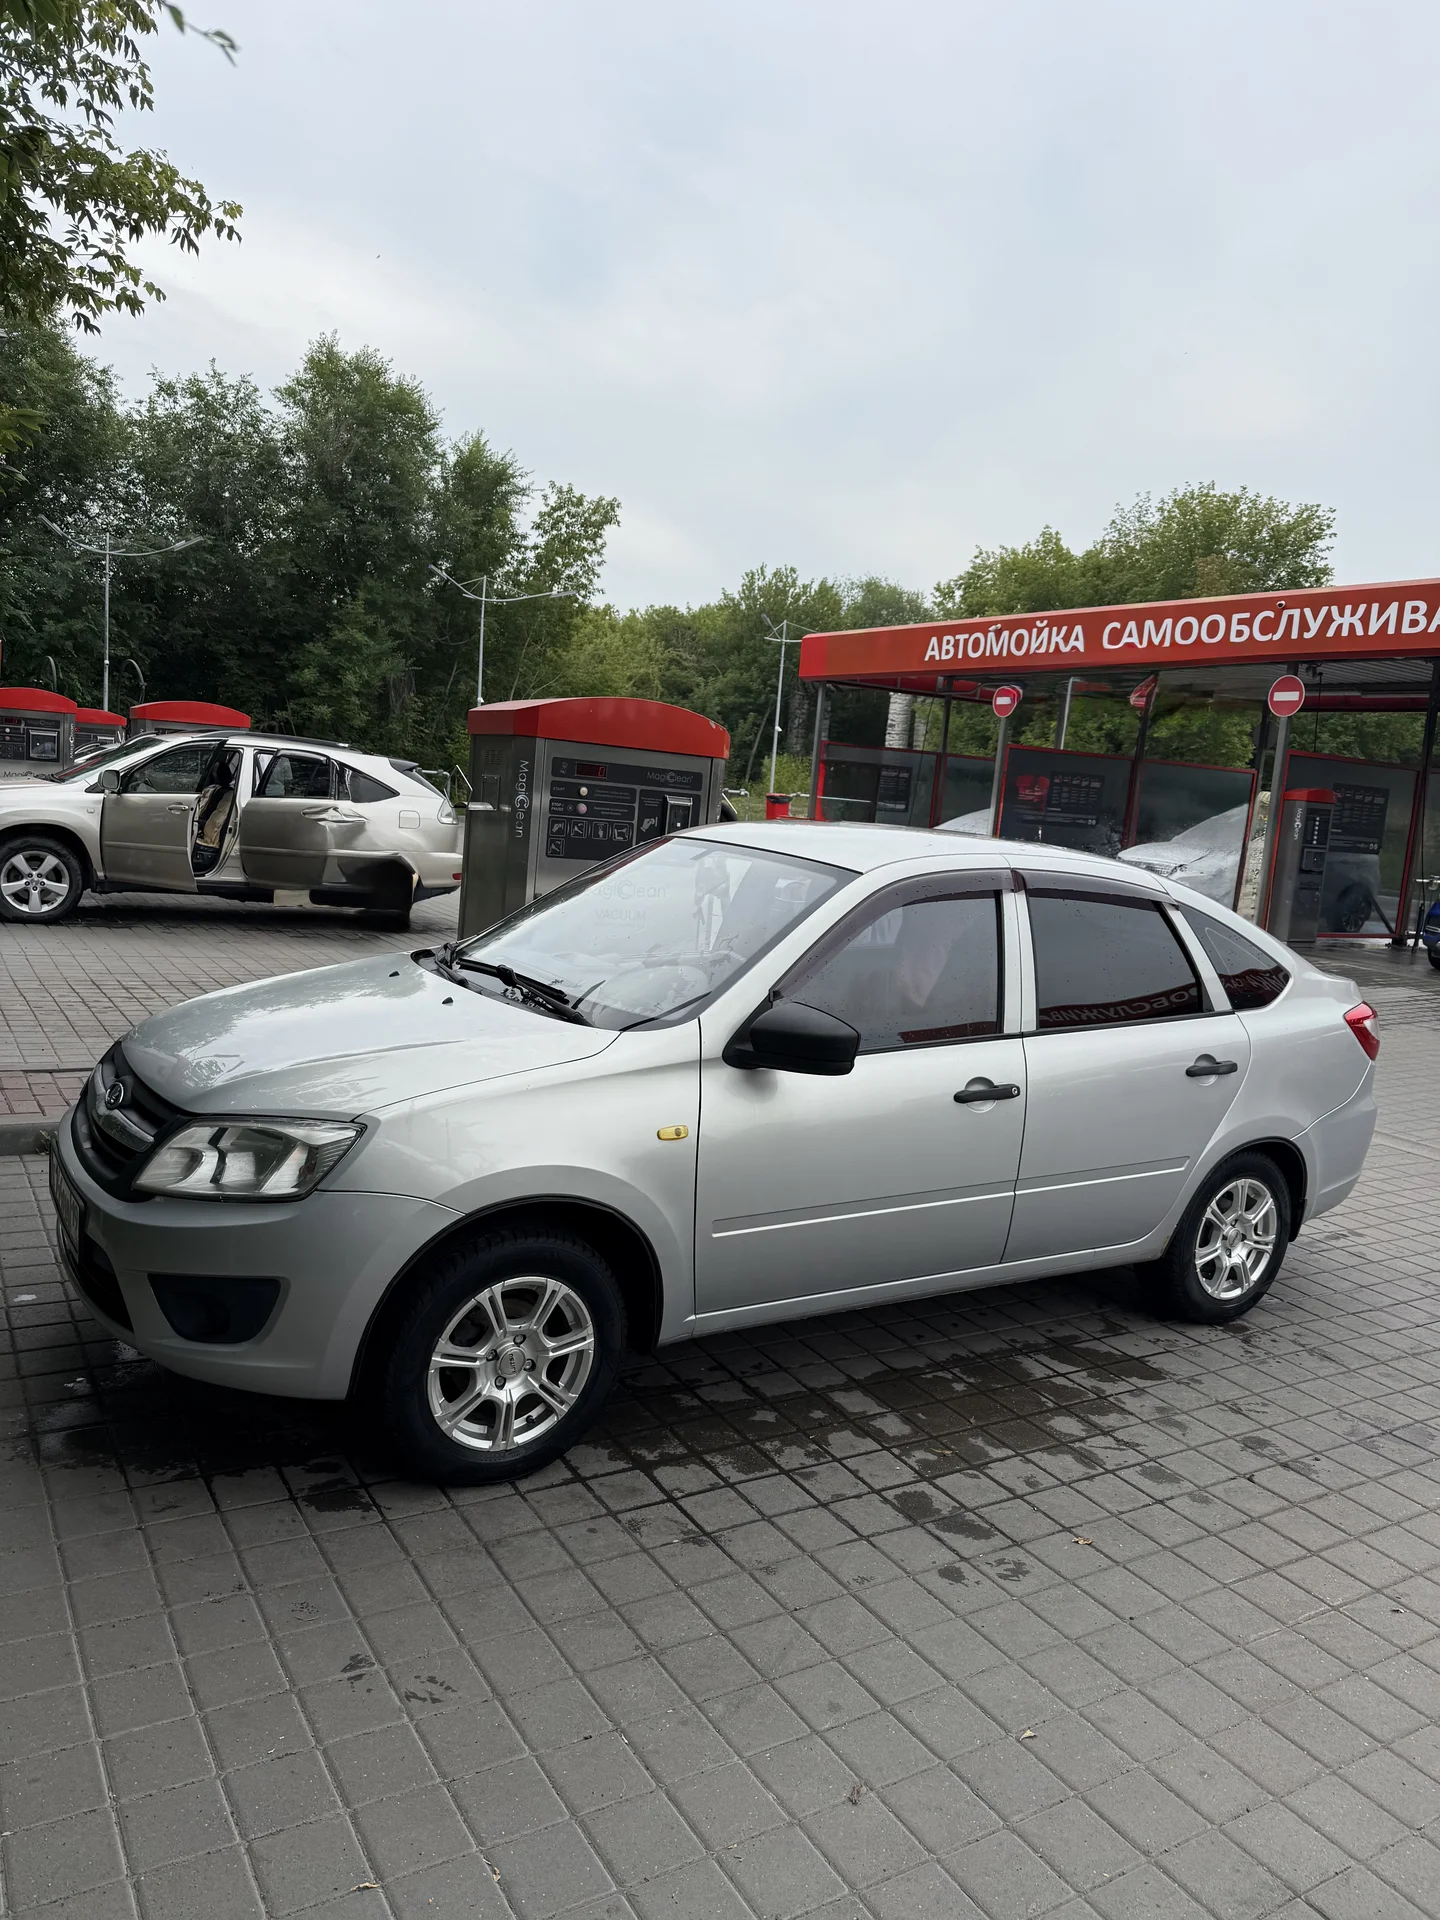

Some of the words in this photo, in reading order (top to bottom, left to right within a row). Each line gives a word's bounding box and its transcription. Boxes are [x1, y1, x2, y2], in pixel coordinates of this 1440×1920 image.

[924, 619, 1085, 661] АВТОМОЙКА
[514, 760, 530, 838] MagiClean
[595, 909, 647, 922] VACUUM
